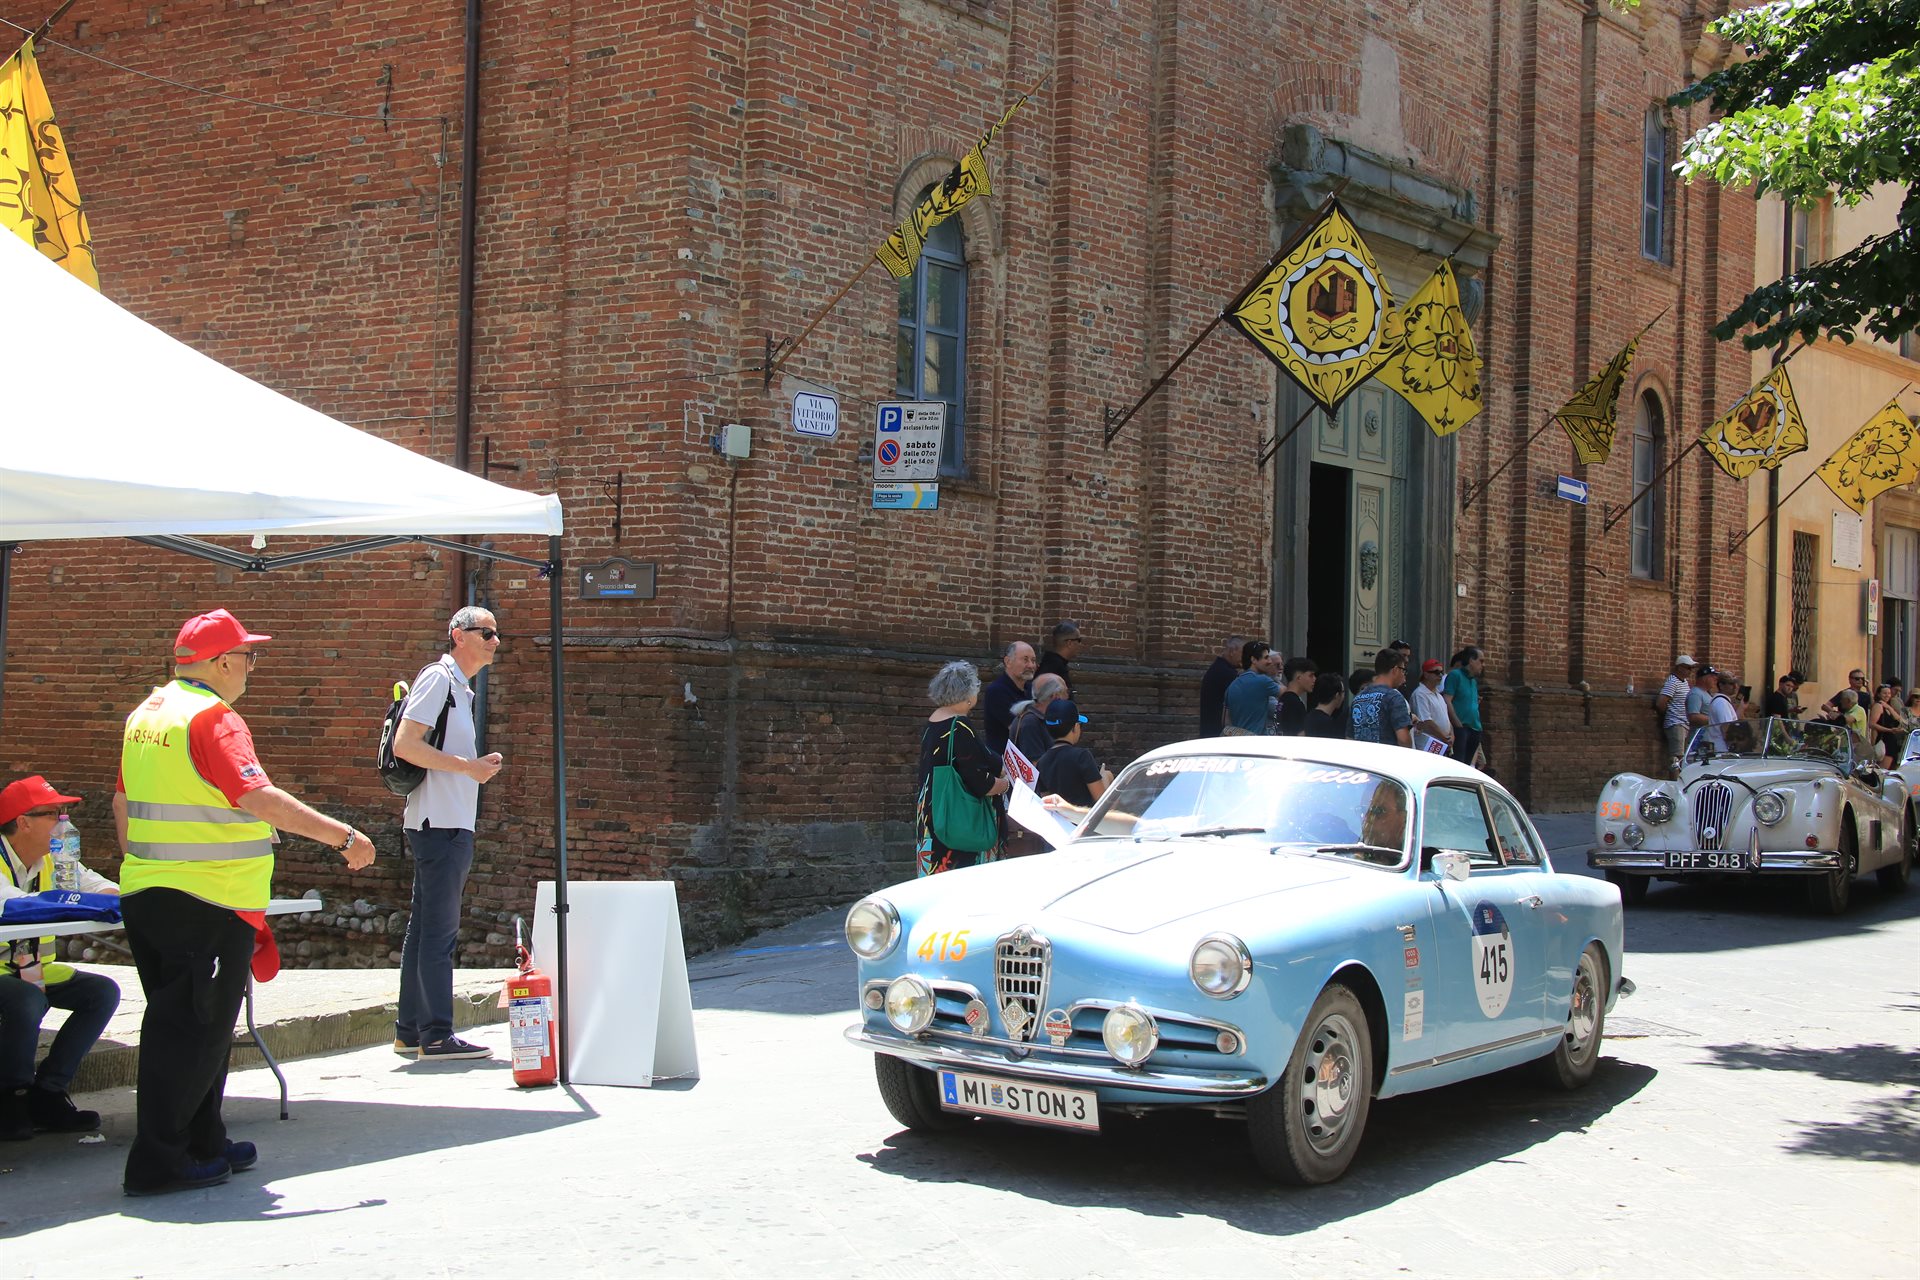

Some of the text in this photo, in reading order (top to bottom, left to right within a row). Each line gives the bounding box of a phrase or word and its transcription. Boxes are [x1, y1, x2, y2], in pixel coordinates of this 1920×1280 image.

[809, 399, 822, 409] VIA
[797, 407, 834, 421] VITTORIO
[800, 419, 830, 431] VENETO
[906, 441, 936, 449] sabato
[127, 729, 170, 747] ARSHAL
[1146, 758, 1237, 776] SCUDERIA
[1599, 801, 1631, 820] 351
[1670, 853, 1740, 869] PFF 948
[917, 929, 971, 962] 415
[1480, 944, 1508, 985] 415
[963, 1079, 987, 1105] MI
